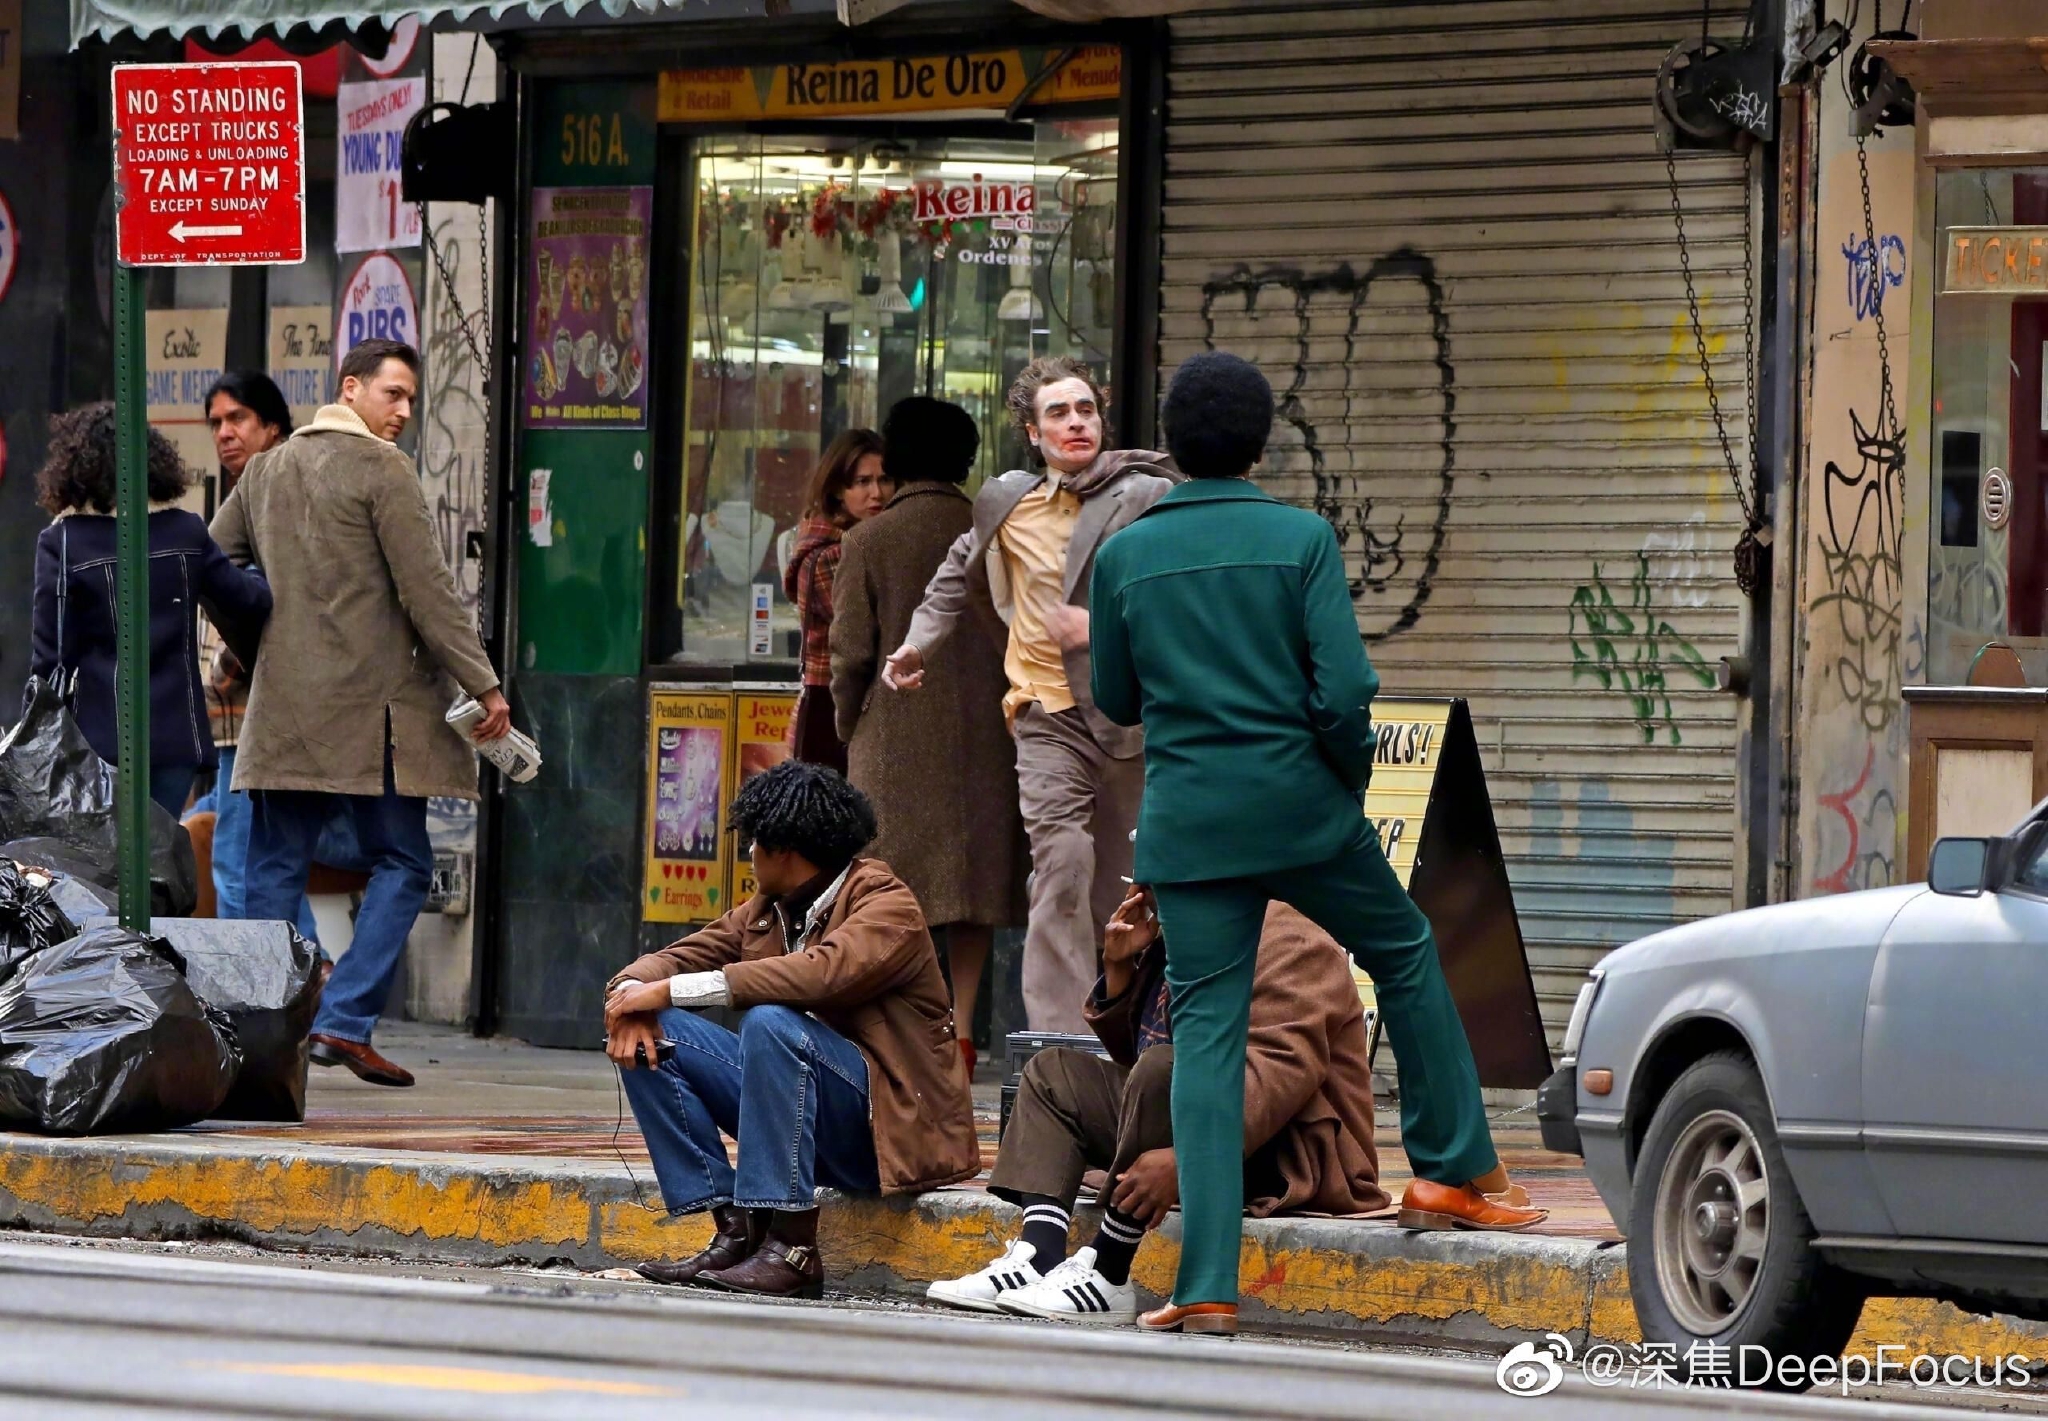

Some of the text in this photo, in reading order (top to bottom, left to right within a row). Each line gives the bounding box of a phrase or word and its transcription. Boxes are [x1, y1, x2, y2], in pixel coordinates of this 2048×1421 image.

[786, 54, 1006, 105] Reina De Oro
[128, 87, 286, 114] NO STANDING
[347, 82, 413, 132] TUESDAYS ONLY!
[136, 120, 279, 143] EXCEPT TRUCKS
[562, 112, 630, 166] 516 A.
[128, 146, 289, 162] LOADING & UNLOADING
[343, 131, 382, 177] YOUNG
[150, 197, 268, 213] EXCEPT SUNDAY
[914, 172, 1037, 221] Reina
[988, 236, 1012, 250] XV
[141, 253, 165, 261] DEPT
[196, 251, 281, 260] TRANSPORTATION
[957, 249, 1043, 266] Ordenes
[163, 327, 201, 358] Exotic
[283, 324, 303, 358] The
[698, 703, 727, 720] Chains
[665, 887, 703, 910] Earrings
